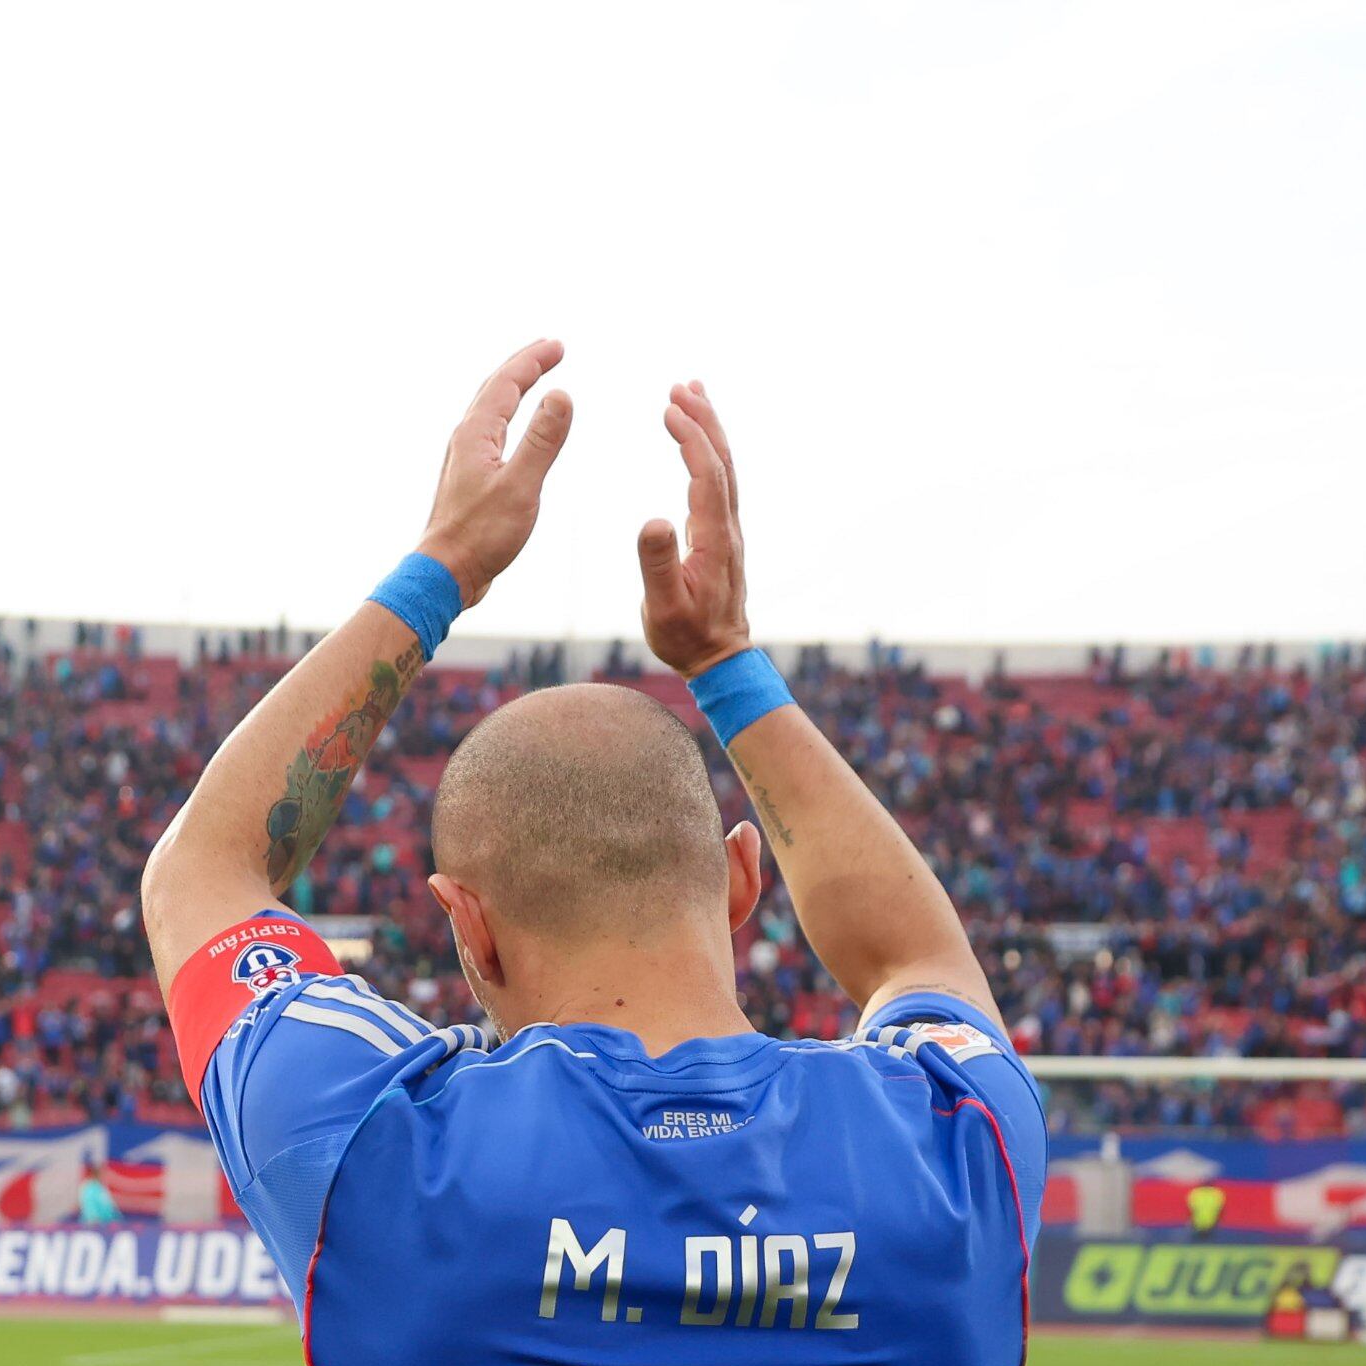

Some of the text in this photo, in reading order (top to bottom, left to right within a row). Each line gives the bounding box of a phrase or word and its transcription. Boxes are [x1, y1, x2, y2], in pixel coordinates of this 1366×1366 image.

[208, 924, 301, 959] CAPITÁN
[663, 1111, 733, 1126] ERES MI
[642, 1125, 685, 1140] VIDA
[538, 1203, 859, 1330] M. DÍAZ
